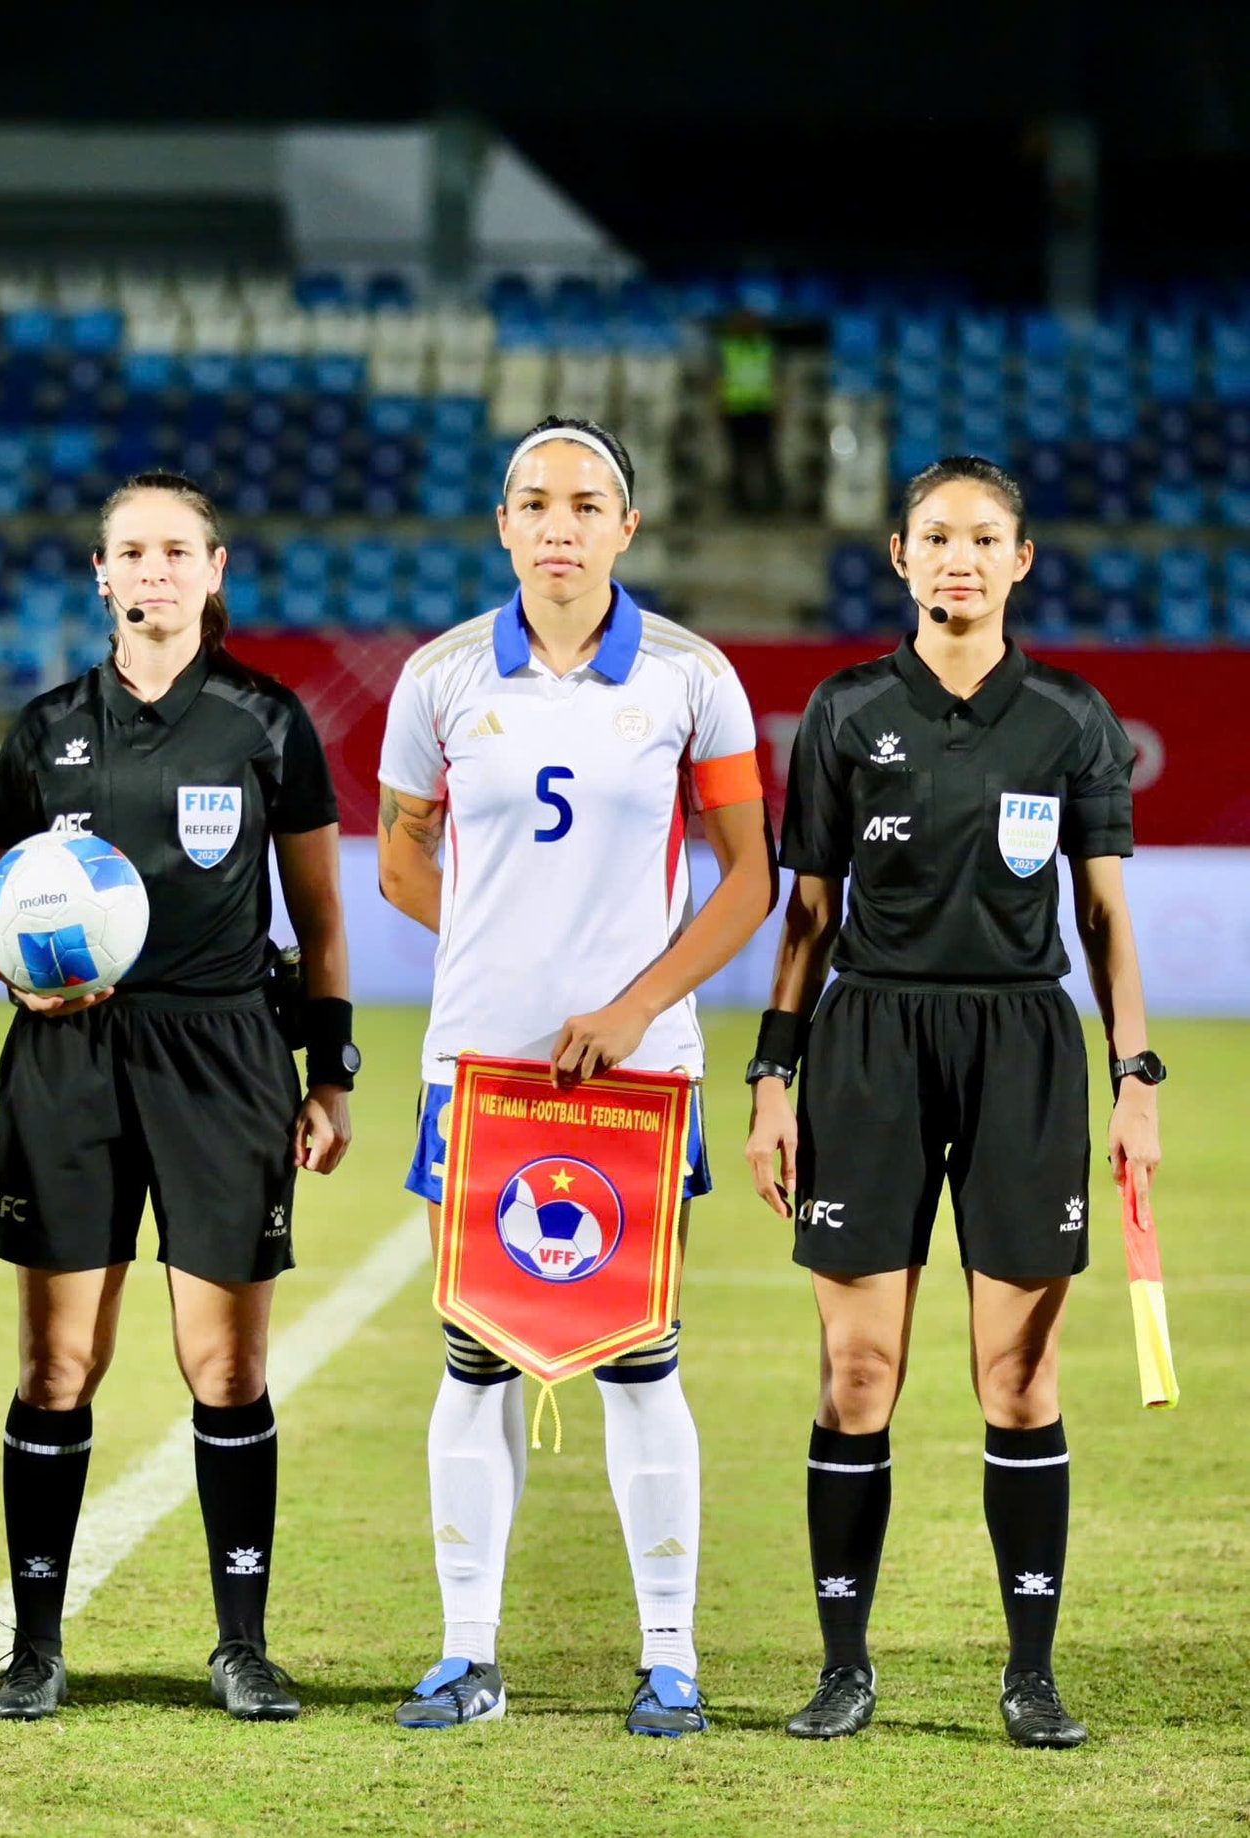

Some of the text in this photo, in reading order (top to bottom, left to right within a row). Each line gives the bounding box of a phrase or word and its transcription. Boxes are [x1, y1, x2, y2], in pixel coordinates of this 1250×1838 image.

[185, 793, 236, 812] FIFA
[534, 766, 575, 843] 5
[1006, 800, 1054, 821] FIFA
[184, 825, 234, 835] REFEREE
[862, 816, 912, 841] AFC
[196, 850, 219, 860] 2025
[1014, 859, 1036, 870] 2025
[18, 893, 68, 910] molten
[479, 1093, 661, 1132] VIETNAM FOOTBALL FEDERATION
[538, 1247, 576, 1267] VFF
[19, 1570, 59, 1578] KELME
[226, 1565, 266, 1575] KELME
